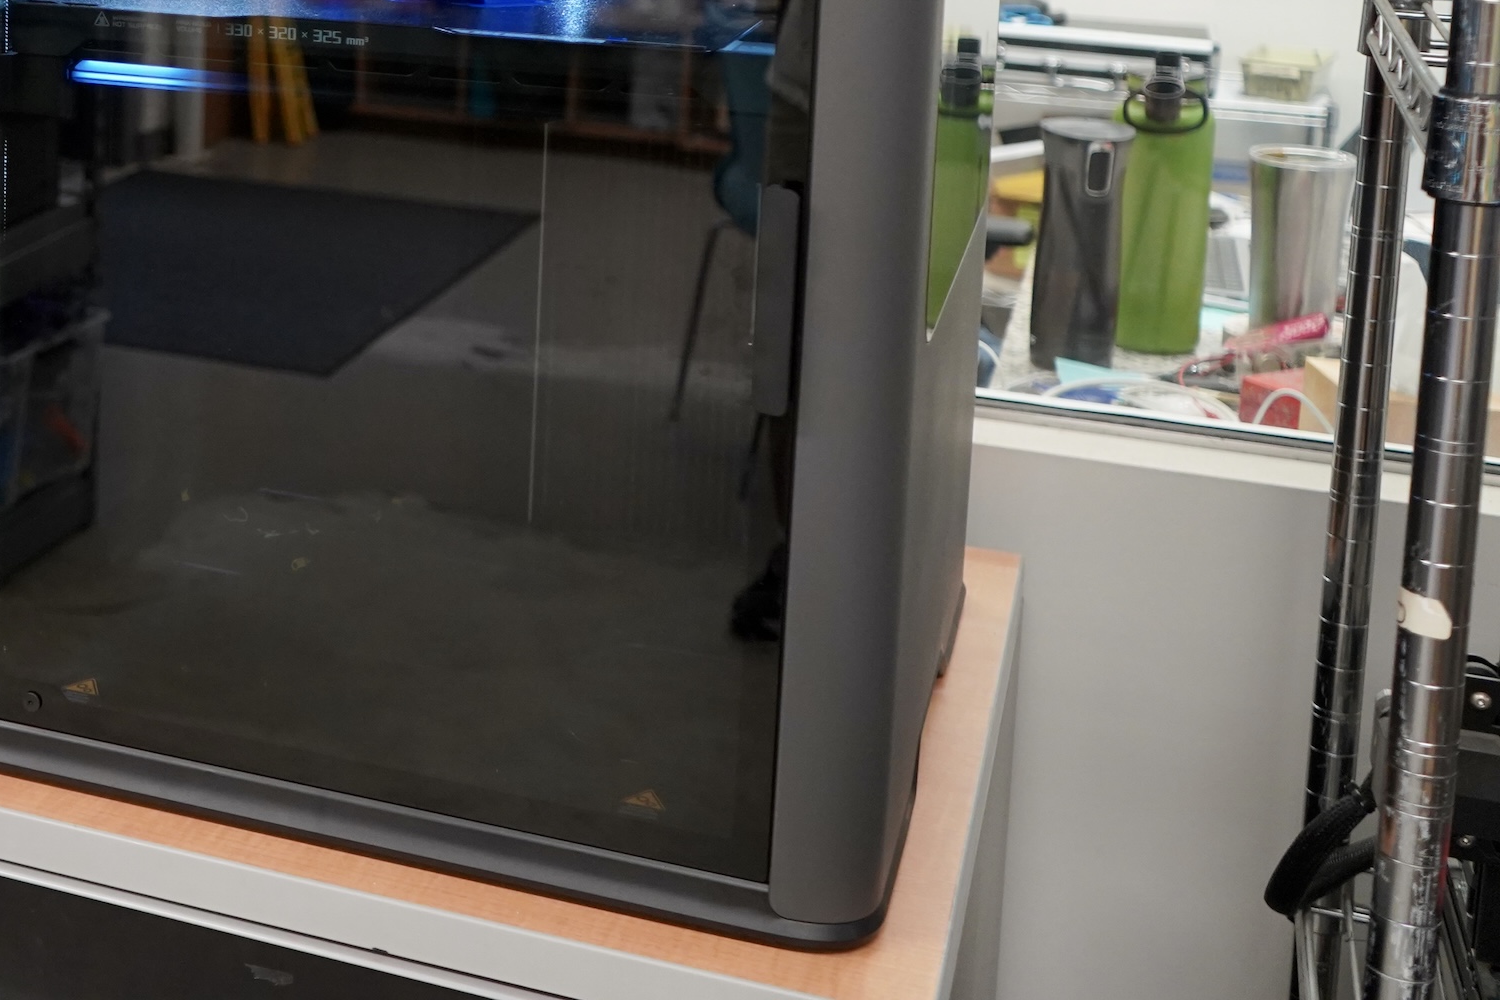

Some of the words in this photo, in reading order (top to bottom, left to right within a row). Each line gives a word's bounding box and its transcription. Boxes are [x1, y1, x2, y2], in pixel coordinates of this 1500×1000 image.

[225, 23, 252, 37] 330
[268, 26, 297, 41] 320
[313, 29, 342, 44] 325
